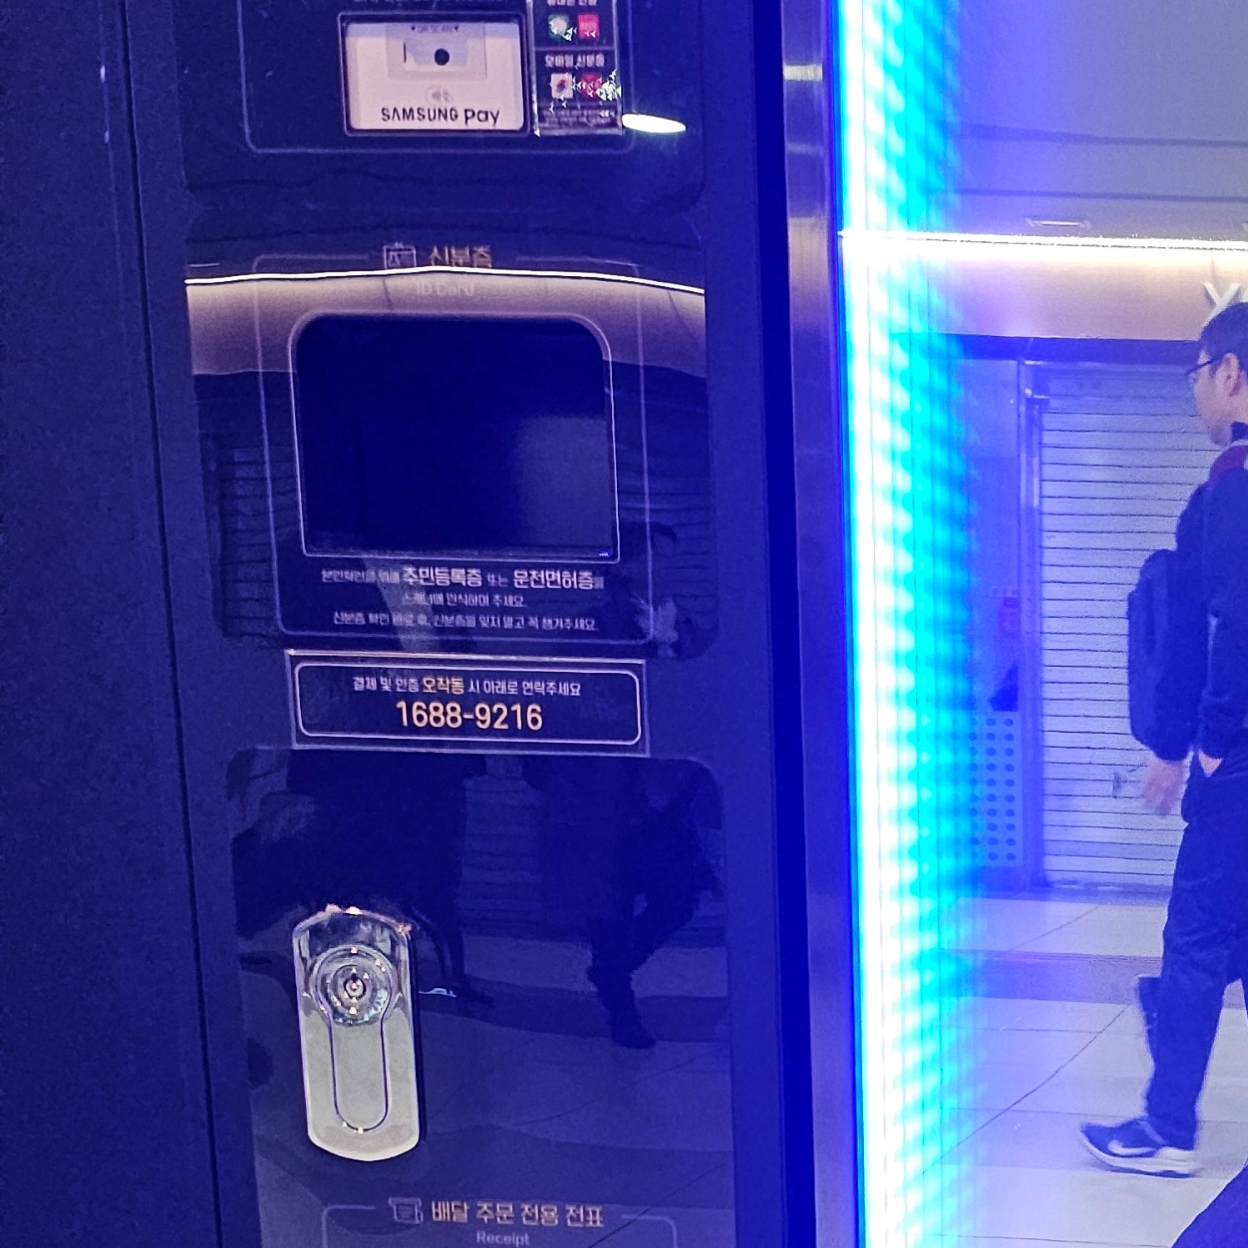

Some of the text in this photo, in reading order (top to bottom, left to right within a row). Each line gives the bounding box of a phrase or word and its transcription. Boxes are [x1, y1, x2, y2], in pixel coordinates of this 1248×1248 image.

[381, 107, 459, 122] SAMSUNG
[416, 281, 475, 297] ID Card
[403, 564, 482, 587] 주민등록증
[487, 572, 508, 587] 또는
[353, 677, 581, 696] 결제 및 인증 오작동 시 아래로 연락주세요
[396, 700, 543, 730] 1688-9216
[431, 1201, 604, 1228] 배달 주문 전용 전표
[476, 1231, 530, 1247] Receipt
